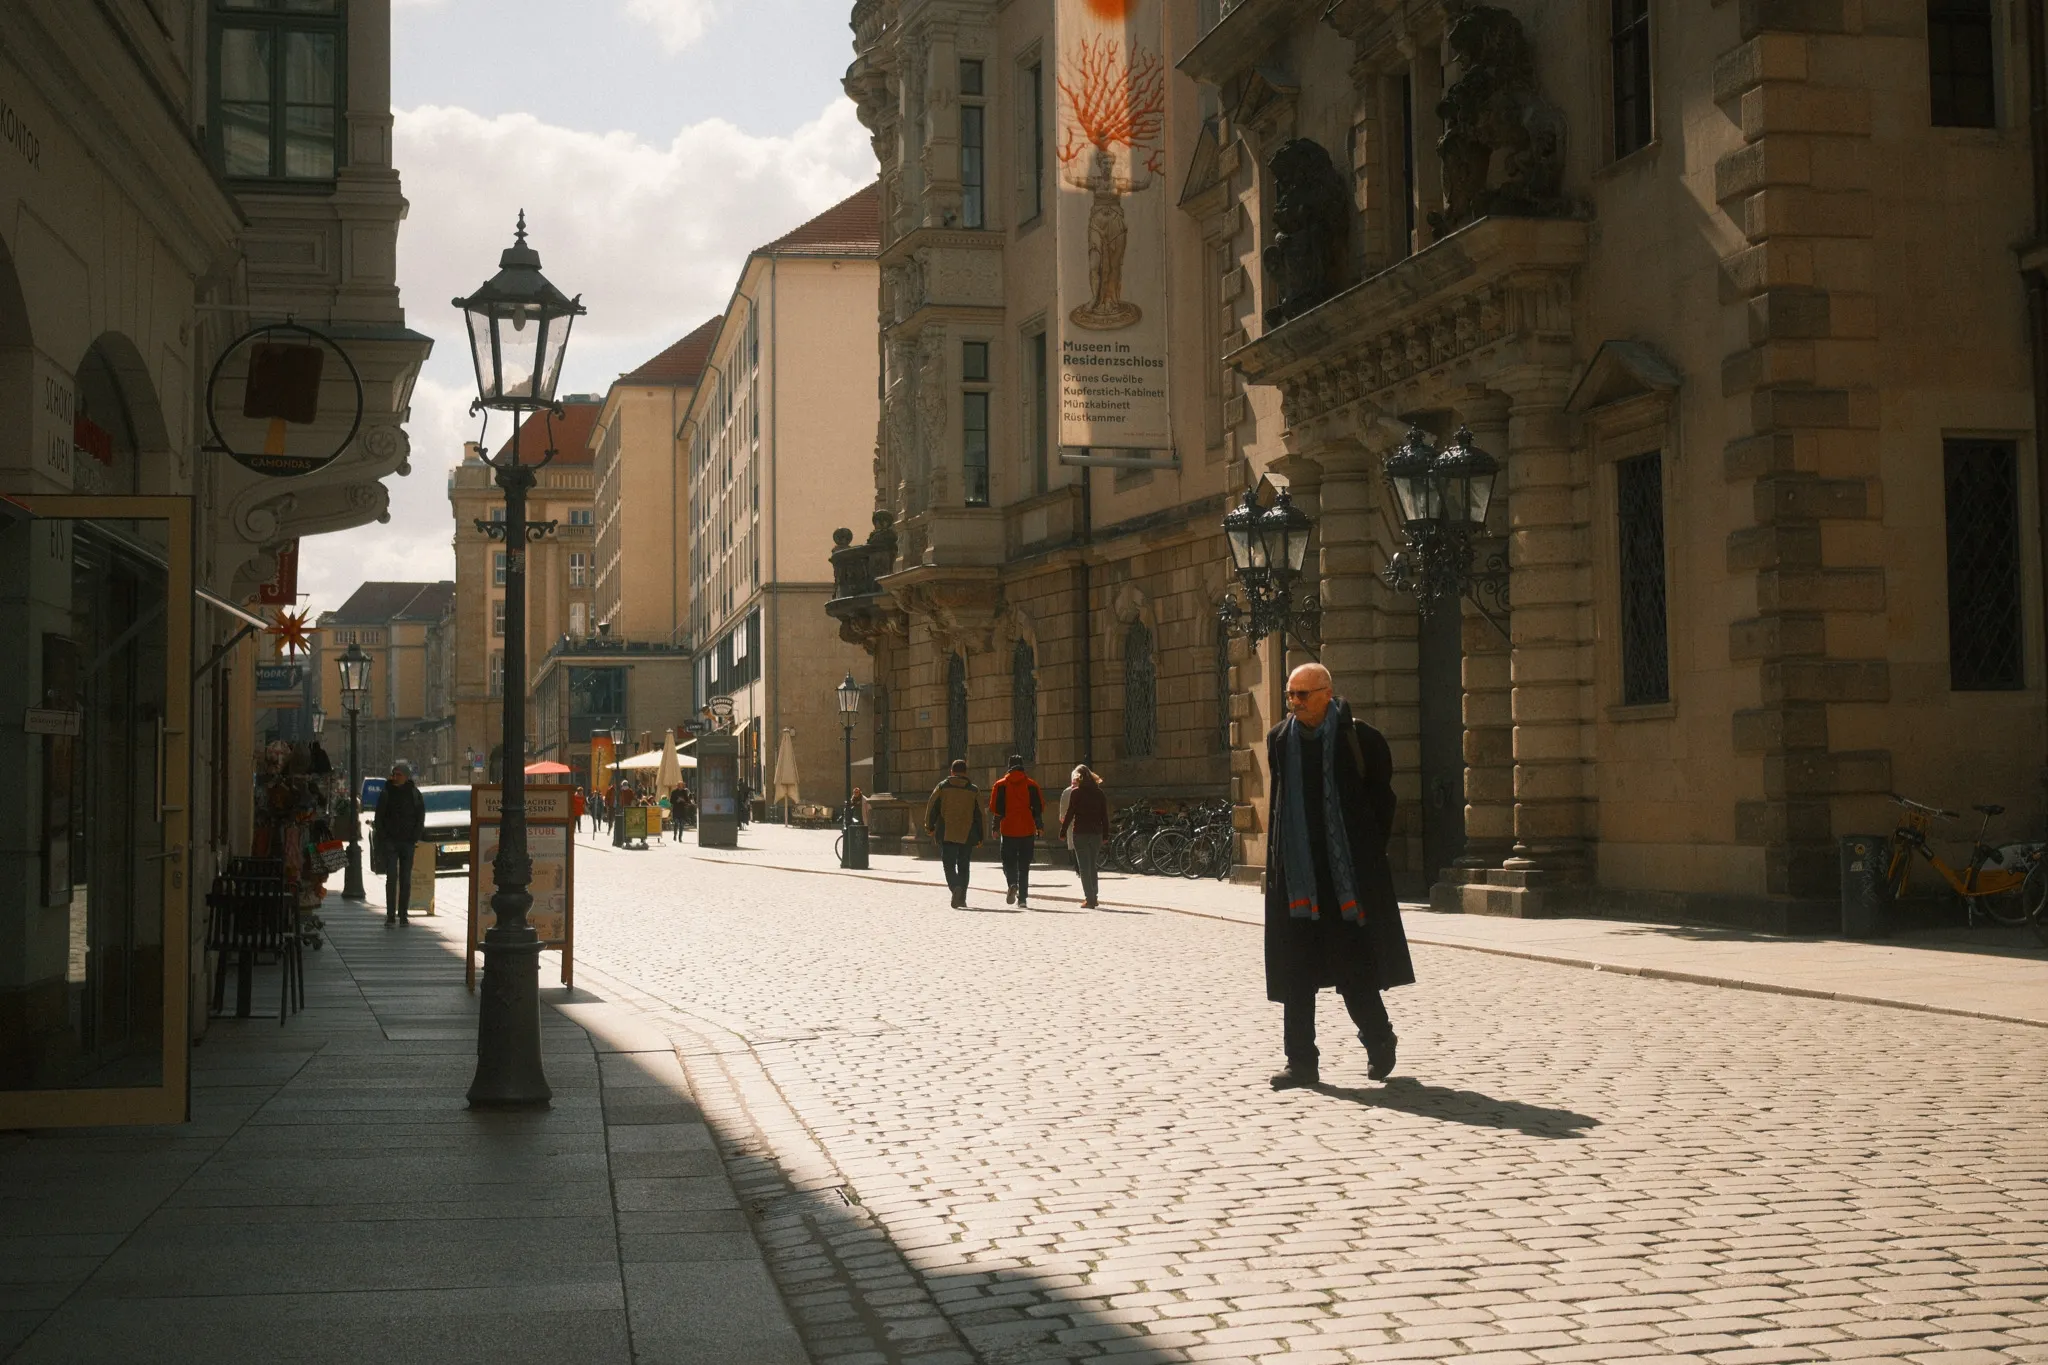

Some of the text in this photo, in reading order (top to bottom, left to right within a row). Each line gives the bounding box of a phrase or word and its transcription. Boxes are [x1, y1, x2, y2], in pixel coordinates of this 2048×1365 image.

[0, 98, 40, 172] KONTOR
[1063, 340, 1131, 353] Museen im
[1063, 354, 1164, 368] Residenzschloss
[1063, 373, 1144, 384] Grünes Gewölbe
[1063, 386, 1165, 398] Kupferstich-Kabinett
[45, 377, 73, 425] SCHOKO
[1063, 399, 1131, 410] Münzkabinett
[1063, 412, 1127, 423] Rüstkammer
[47, 431, 71, 475] LADEN
[251, 457, 312, 469] CAMONDAS
[485, 798, 557, 806] HANACHTES
